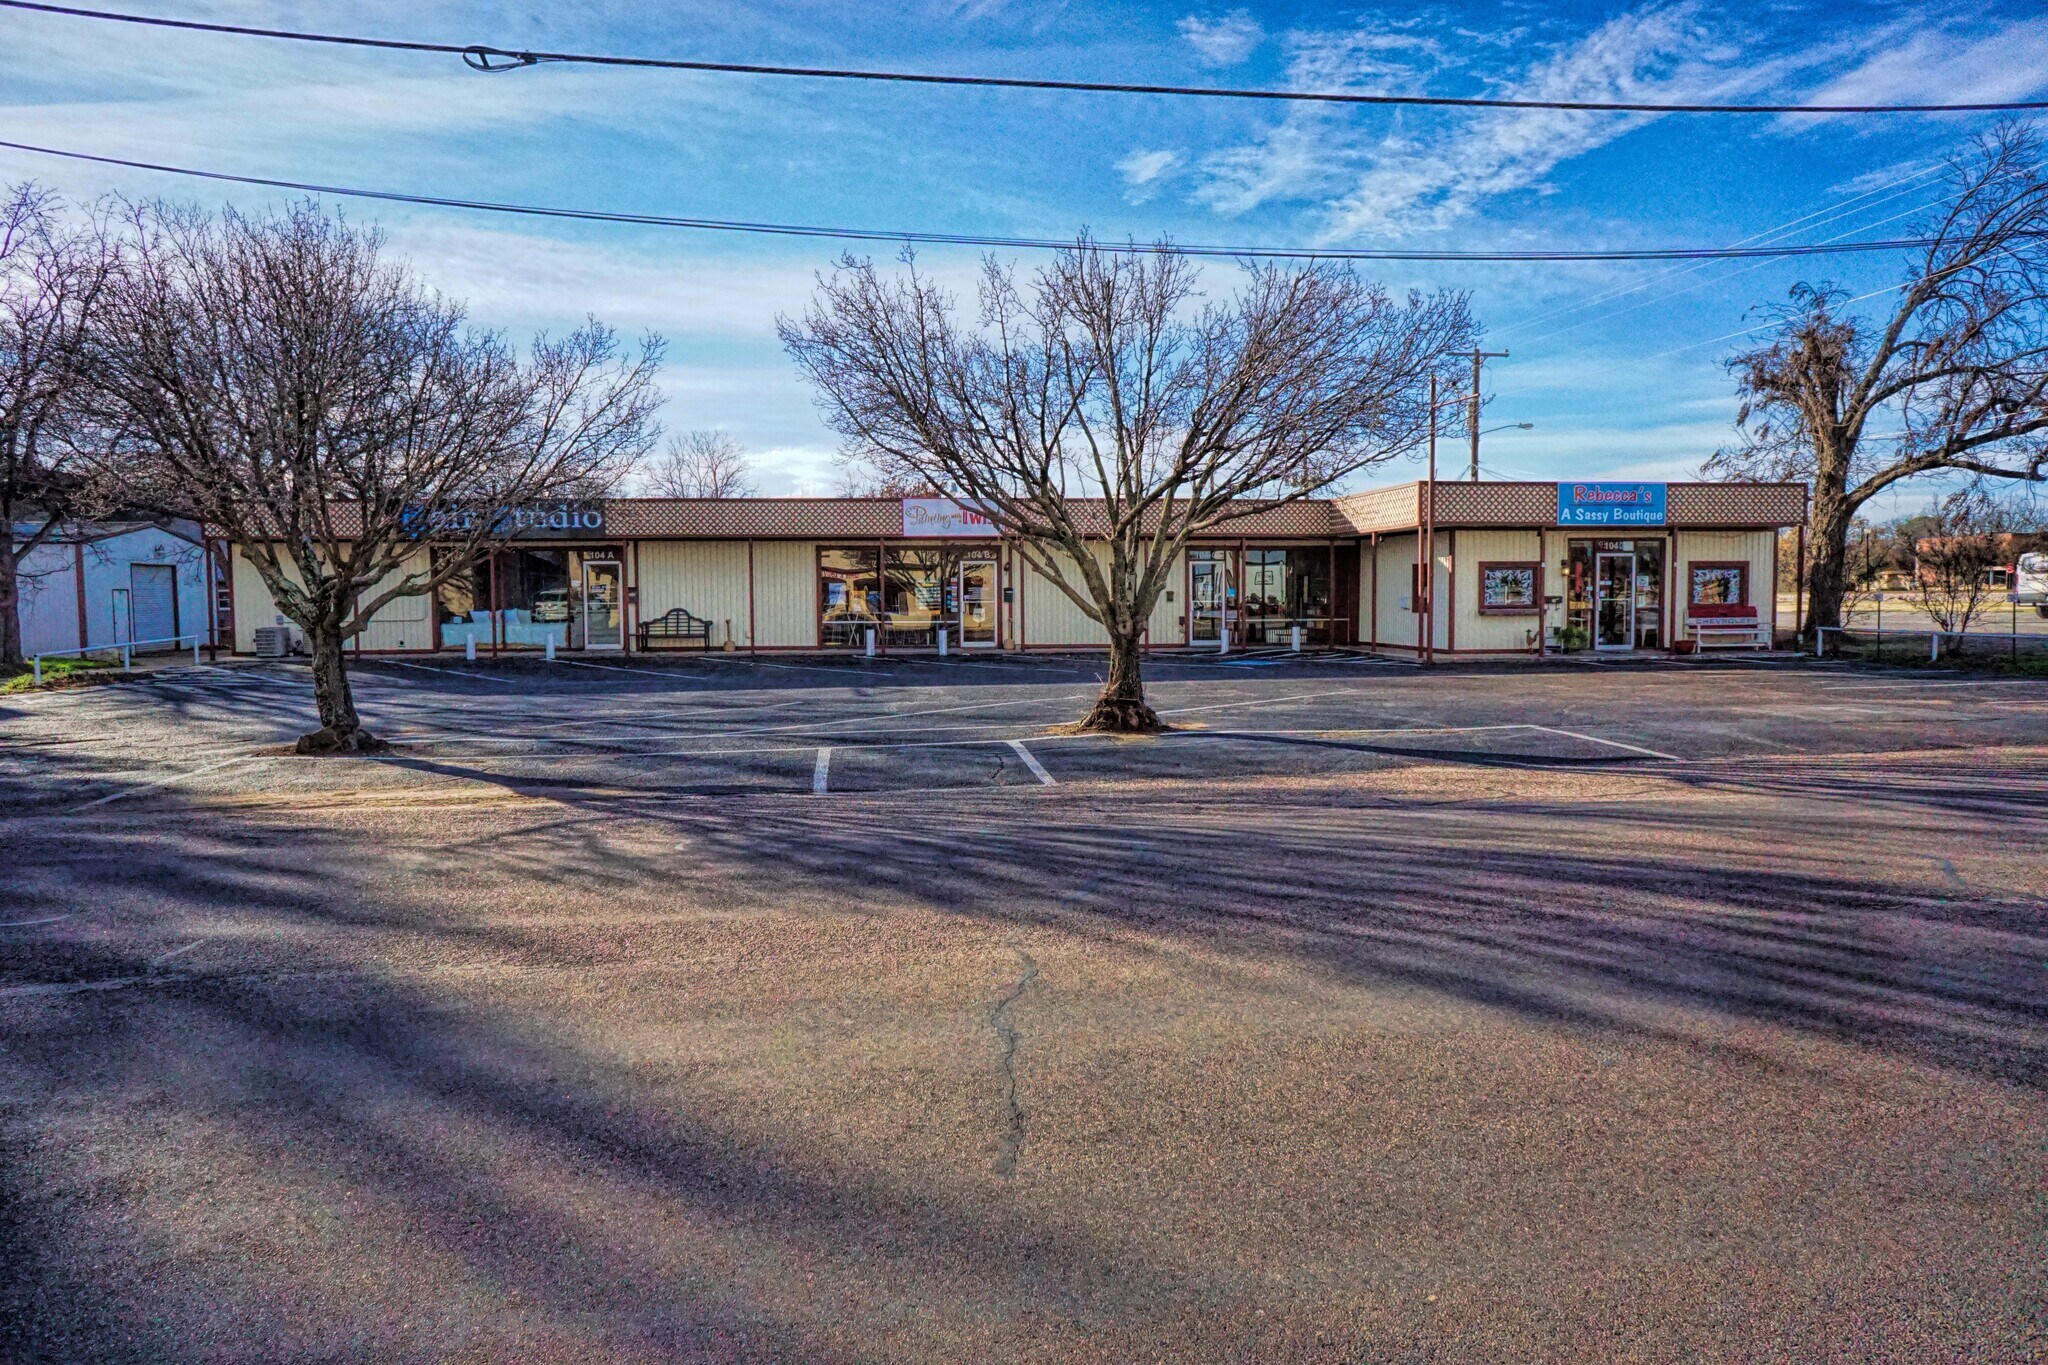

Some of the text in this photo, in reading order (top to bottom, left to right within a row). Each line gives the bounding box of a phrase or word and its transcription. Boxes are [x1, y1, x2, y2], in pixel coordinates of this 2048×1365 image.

[1573, 485, 1652, 503] Rebecca's
[904, 505, 952, 529] Painting
[1560, 508, 1663, 523] A Sassy Boutique
[590, 551, 615, 559] 104 A
